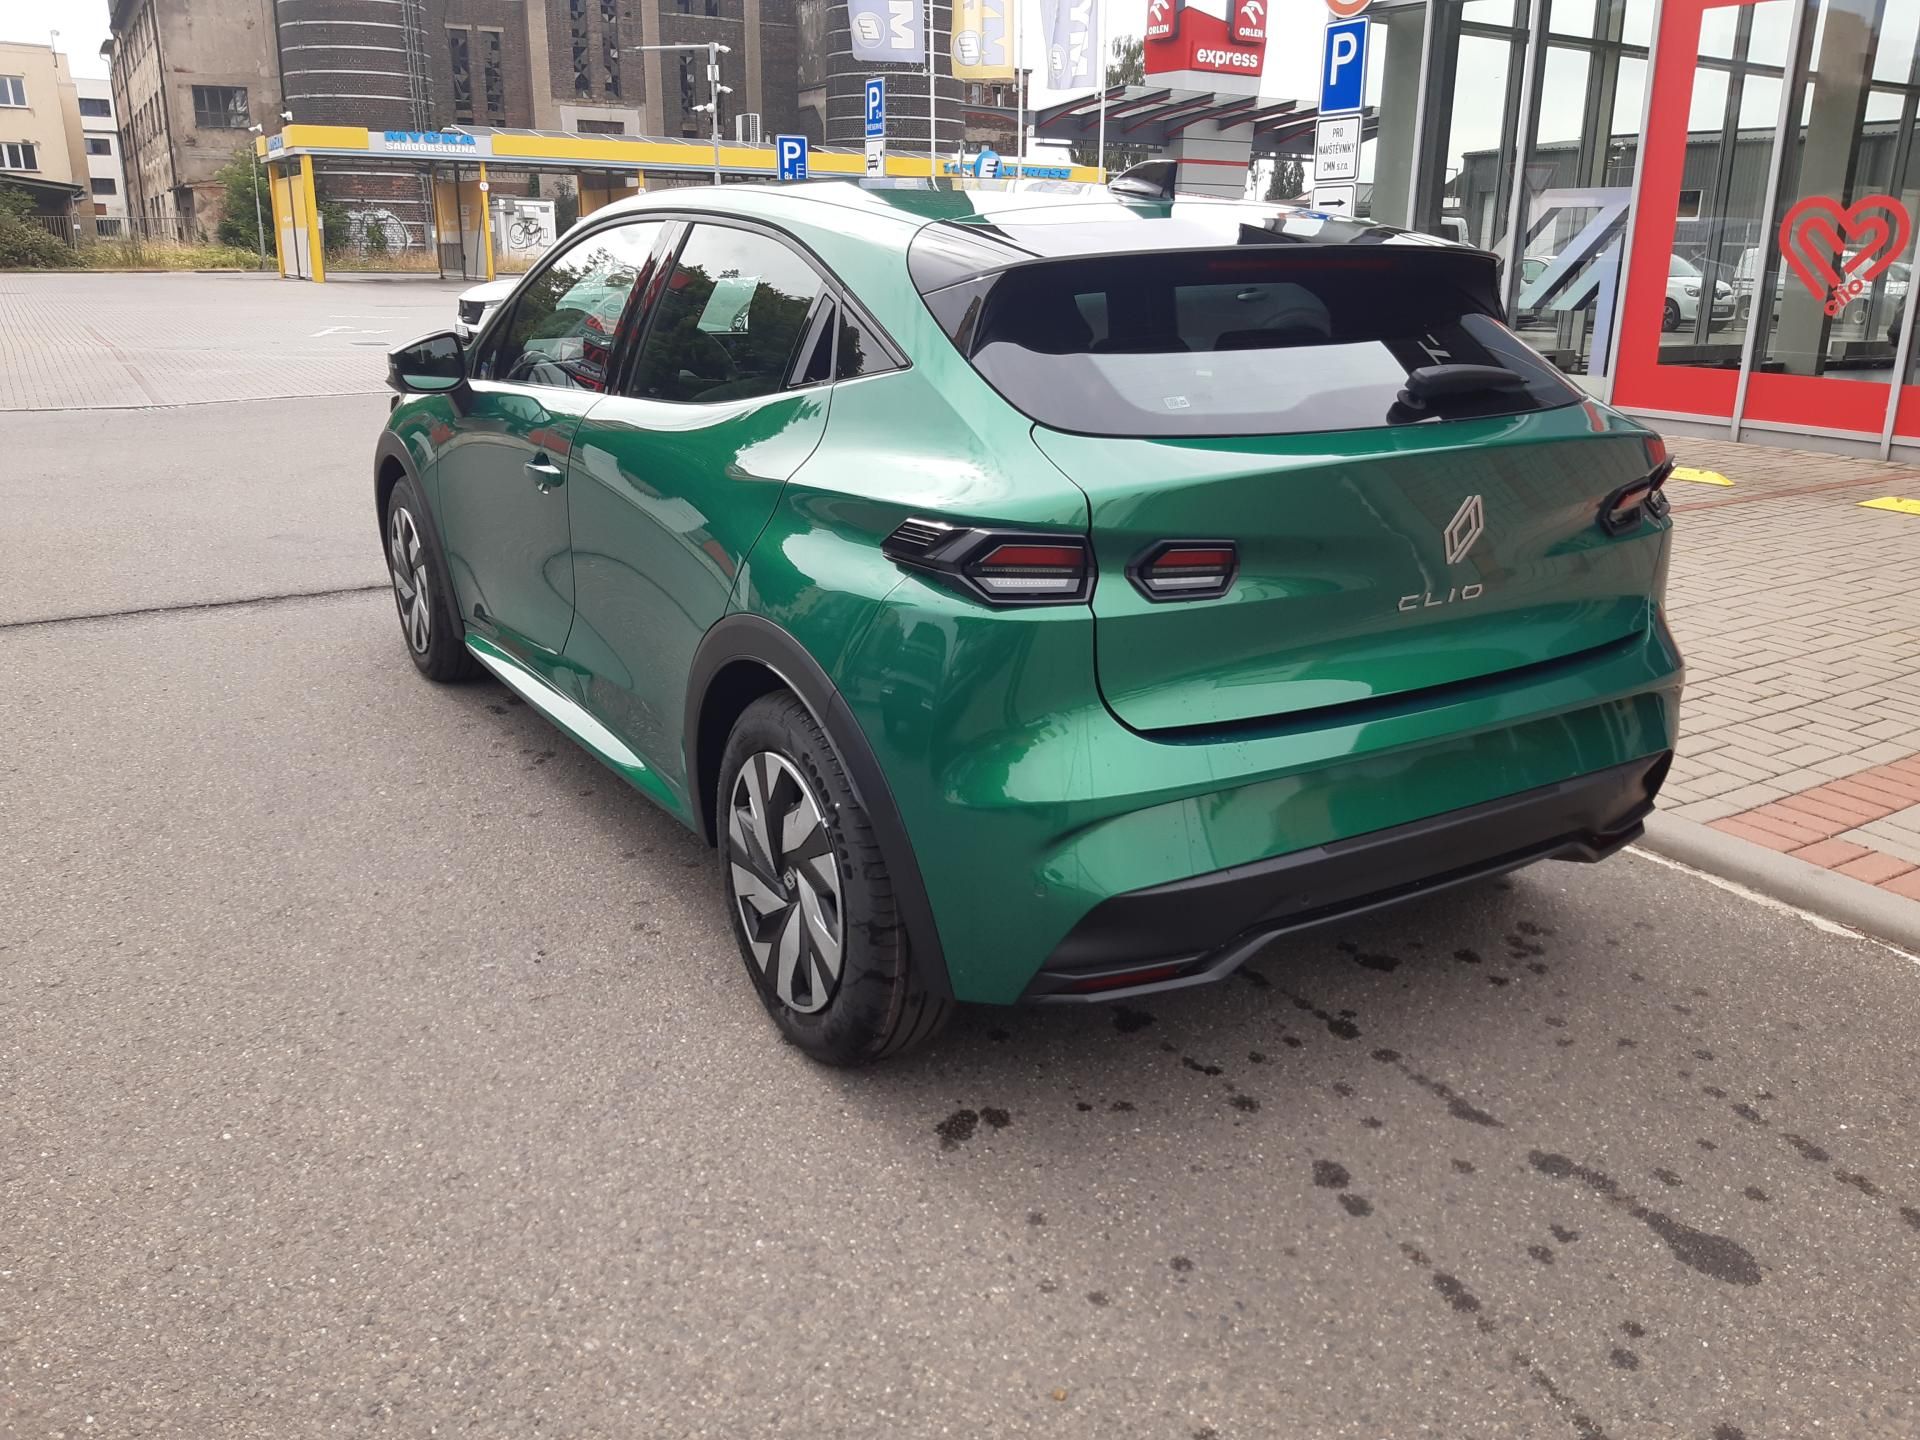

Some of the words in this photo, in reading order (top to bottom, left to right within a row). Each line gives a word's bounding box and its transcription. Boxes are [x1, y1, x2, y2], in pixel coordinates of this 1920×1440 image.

[1148, 24, 1169, 35] ORLEN
[1239, 27, 1264, 37] ORLEN
[1197, 48, 1258, 68] express
[1329, 31, 1357, 86] P
[868, 87, 880, 120] P
[1332, 127, 1344, 138] PRO
[783, 142, 801, 169] P
[1824, 278, 1865, 316] clio
[1397, 583, 1483, 612] CLIO
